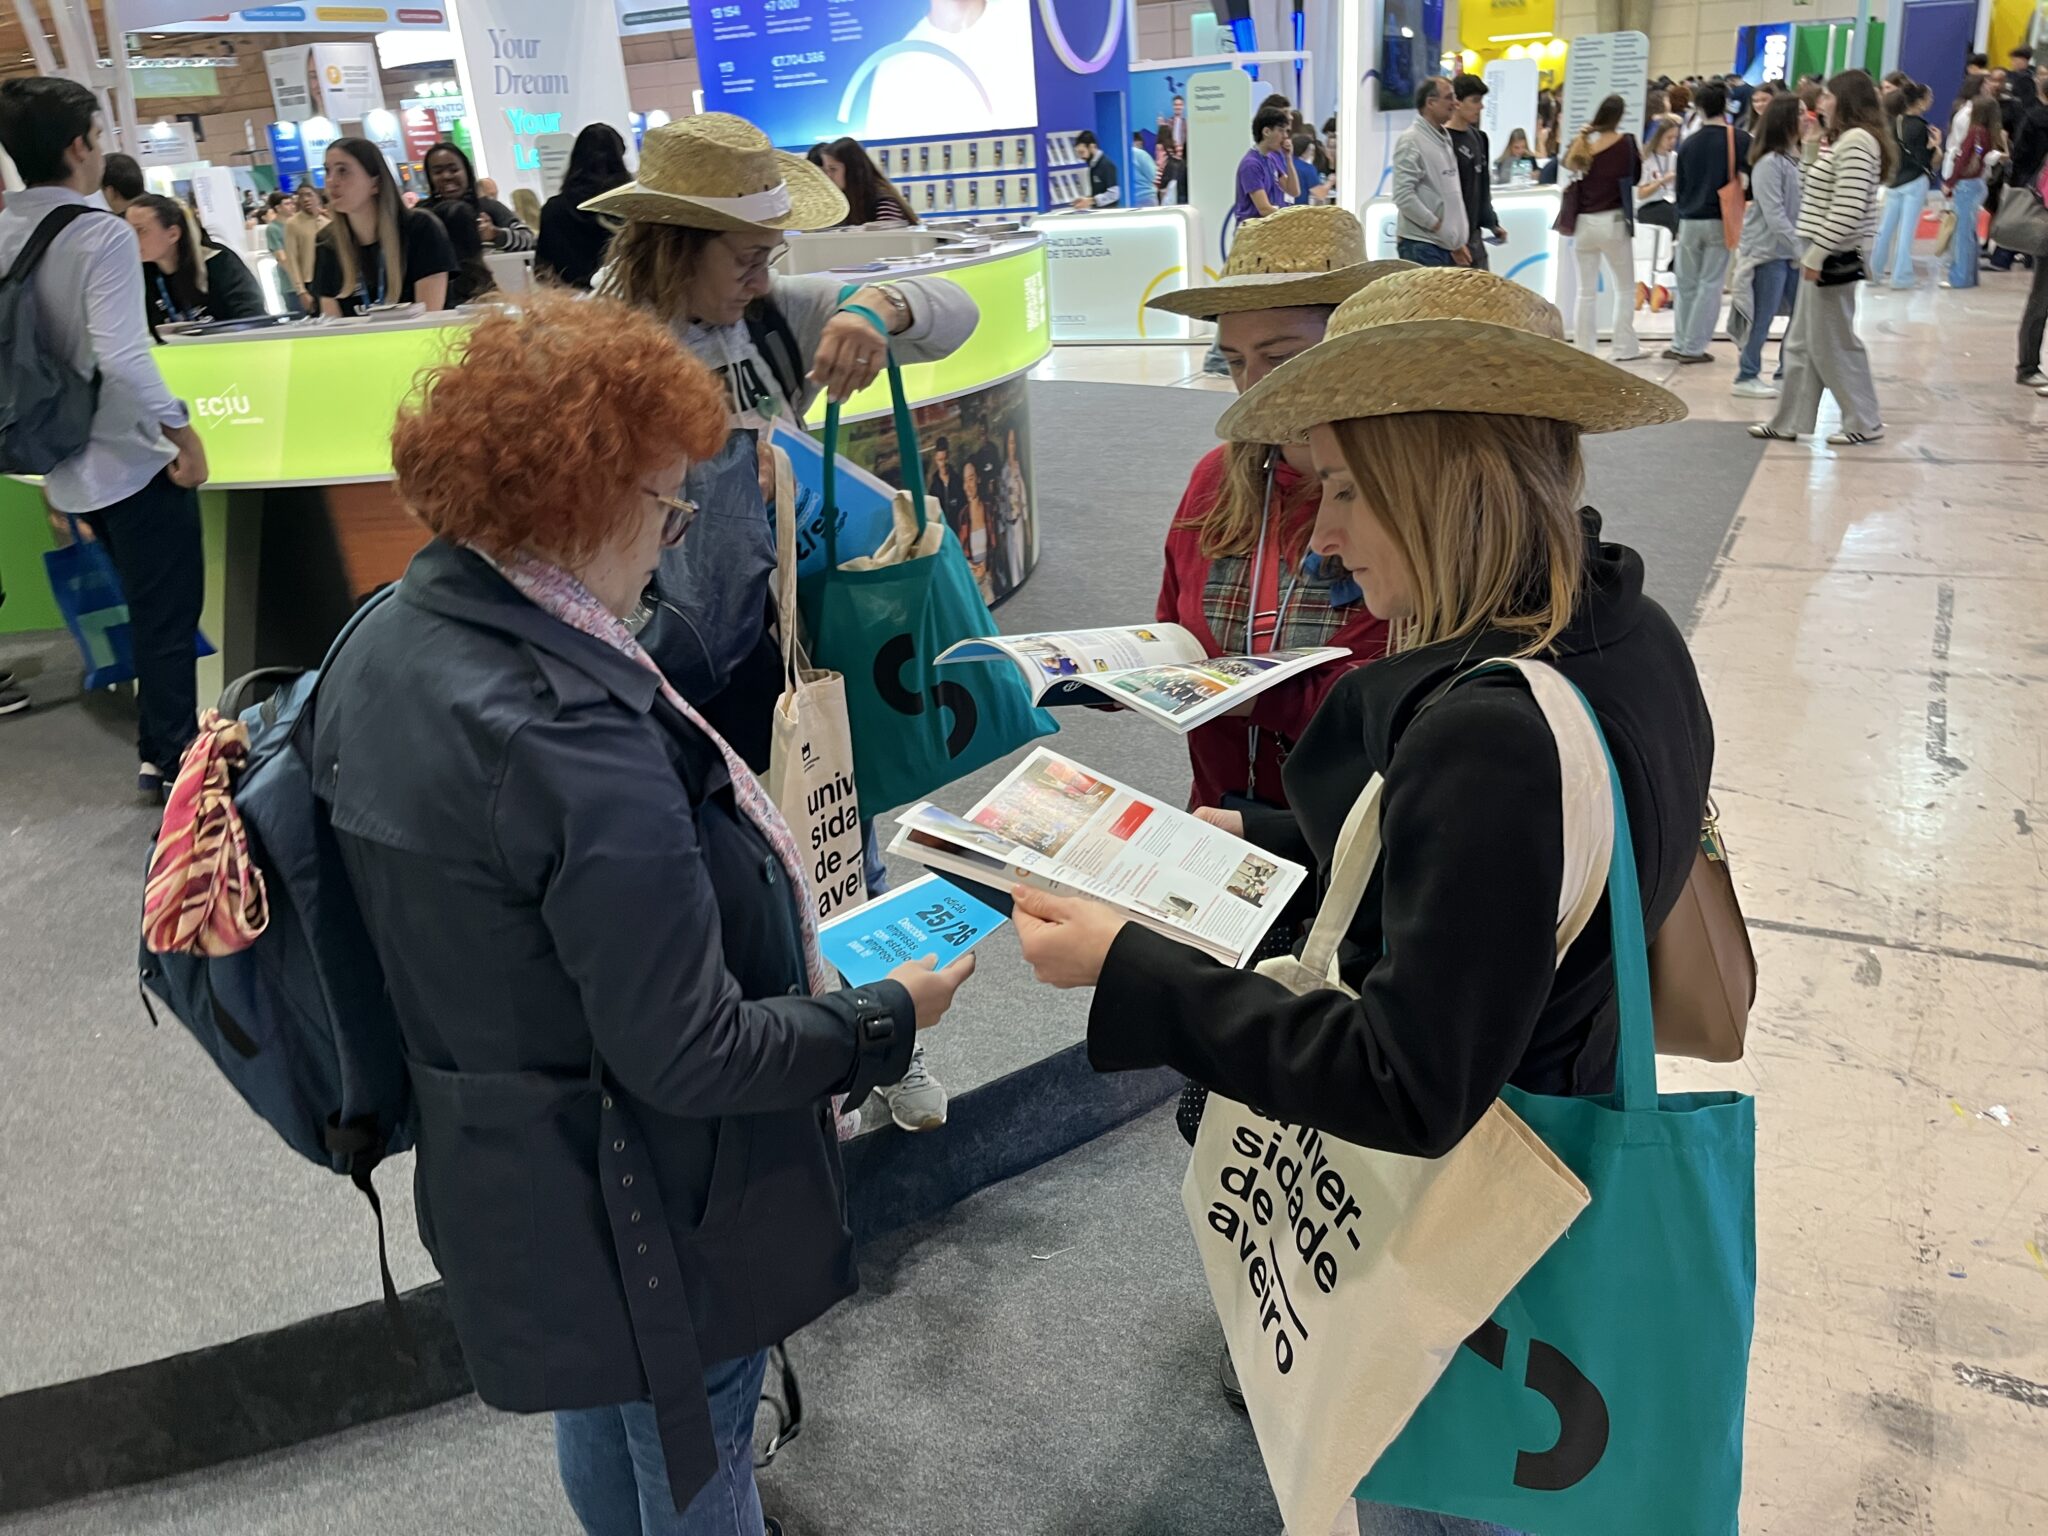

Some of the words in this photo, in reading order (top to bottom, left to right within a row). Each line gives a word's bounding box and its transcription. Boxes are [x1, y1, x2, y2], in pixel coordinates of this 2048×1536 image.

[488, 29, 541, 59] Your
[494, 65, 569, 95] Dream
[505, 107, 563, 136] Your
[194, 394, 250, 417] ECIU
[815, 850, 842, 884] de
[943, 896, 967, 914] edição
[886, 924, 919, 951] empresas
[915, 904, 978, 946] 25/26
[1220, 1166, 1274, 1226] de
[1232, 1126, 1338, 1294] sidade
[1207, 1201, 1294, 1375] aveiro
